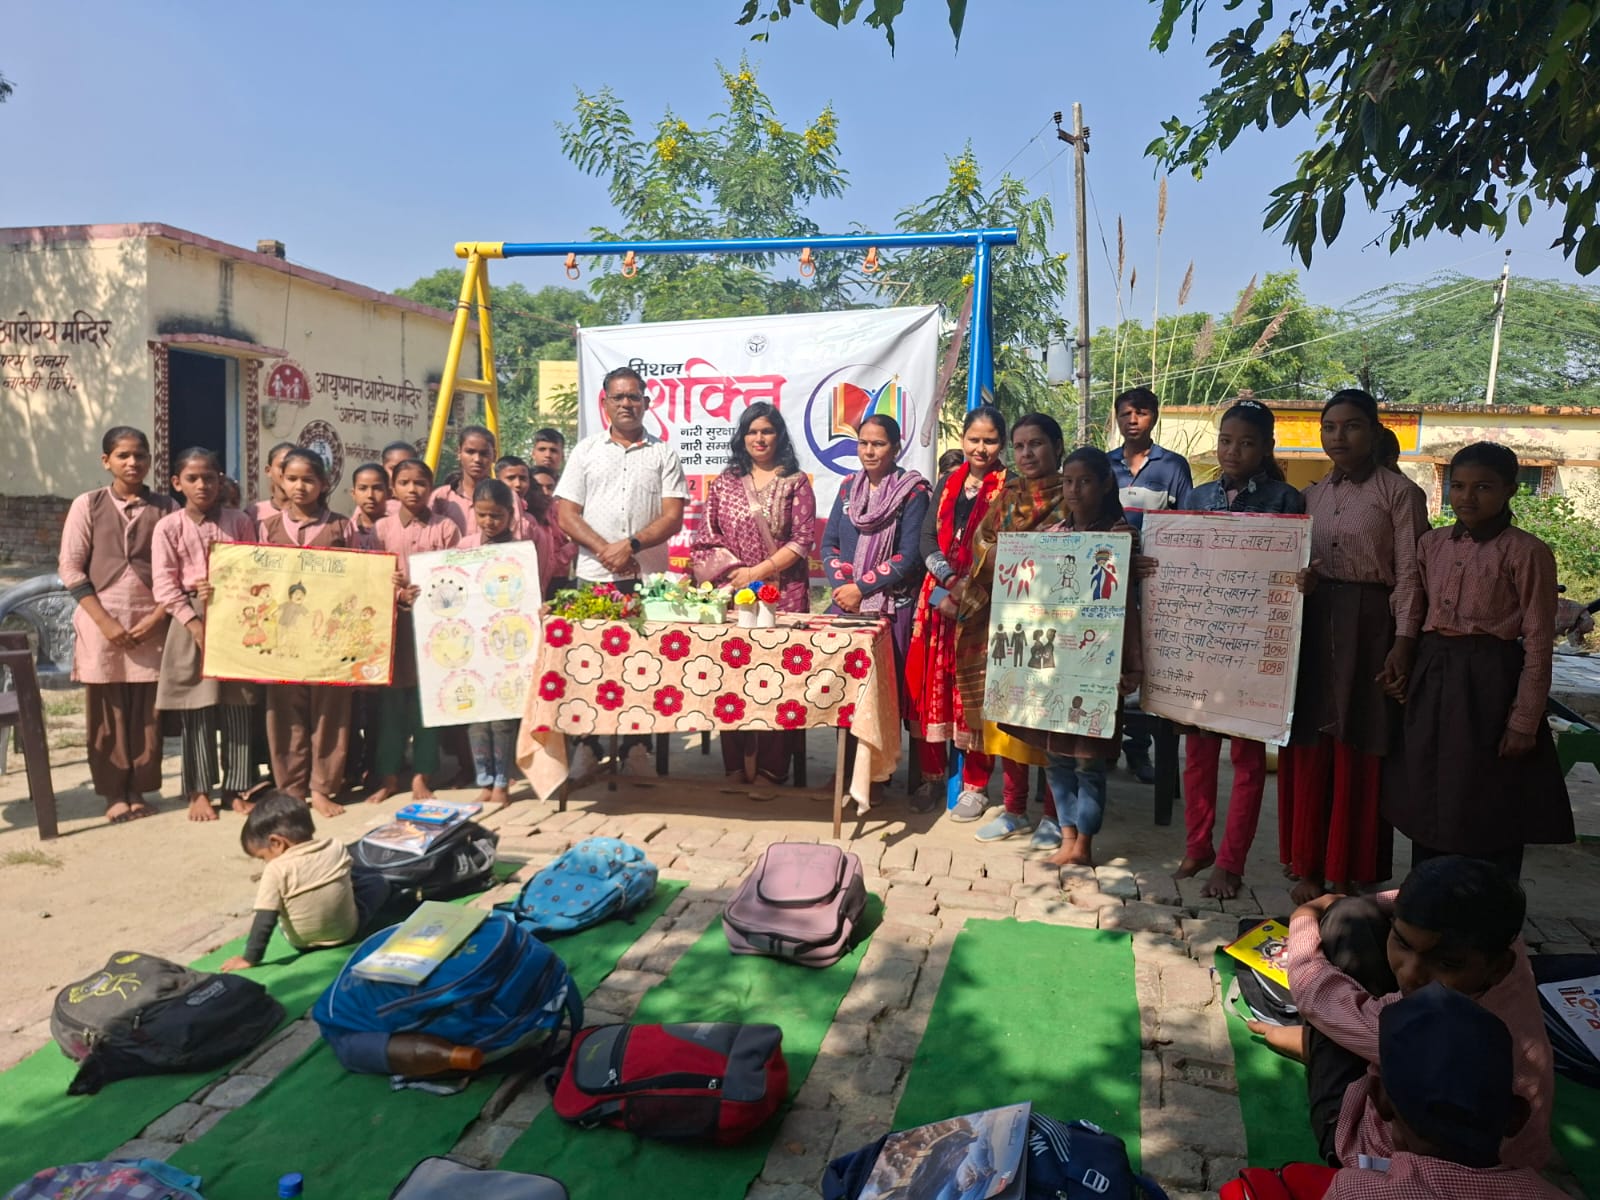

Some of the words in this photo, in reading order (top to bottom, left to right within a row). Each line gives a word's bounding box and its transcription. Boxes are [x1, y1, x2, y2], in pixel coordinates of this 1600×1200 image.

[0, 310, 57, 346] आरोग्य
[61, 310, 112, 349] मन्दिर
[629, 358, 684, 377] मिशन
[315, 372, 363, 400] आयुष्मान
[364, 375, 397, 402] आरोग्य
[397, 379, 422, 409] मन्दिर
[680, 425, 702, 436] नारी
[705, 427, 736, 441] सुरक्षा
[680, 439, 702, 451] नारी
[680, 453, 702, 465] नारी
[1241, 536, 1275, 551] लाइन
[1160, 562, 1190, 580] पुलिस
[1216, 569, 1248, 584] लाइन
[1261, 661, 1282, 674] 1098
